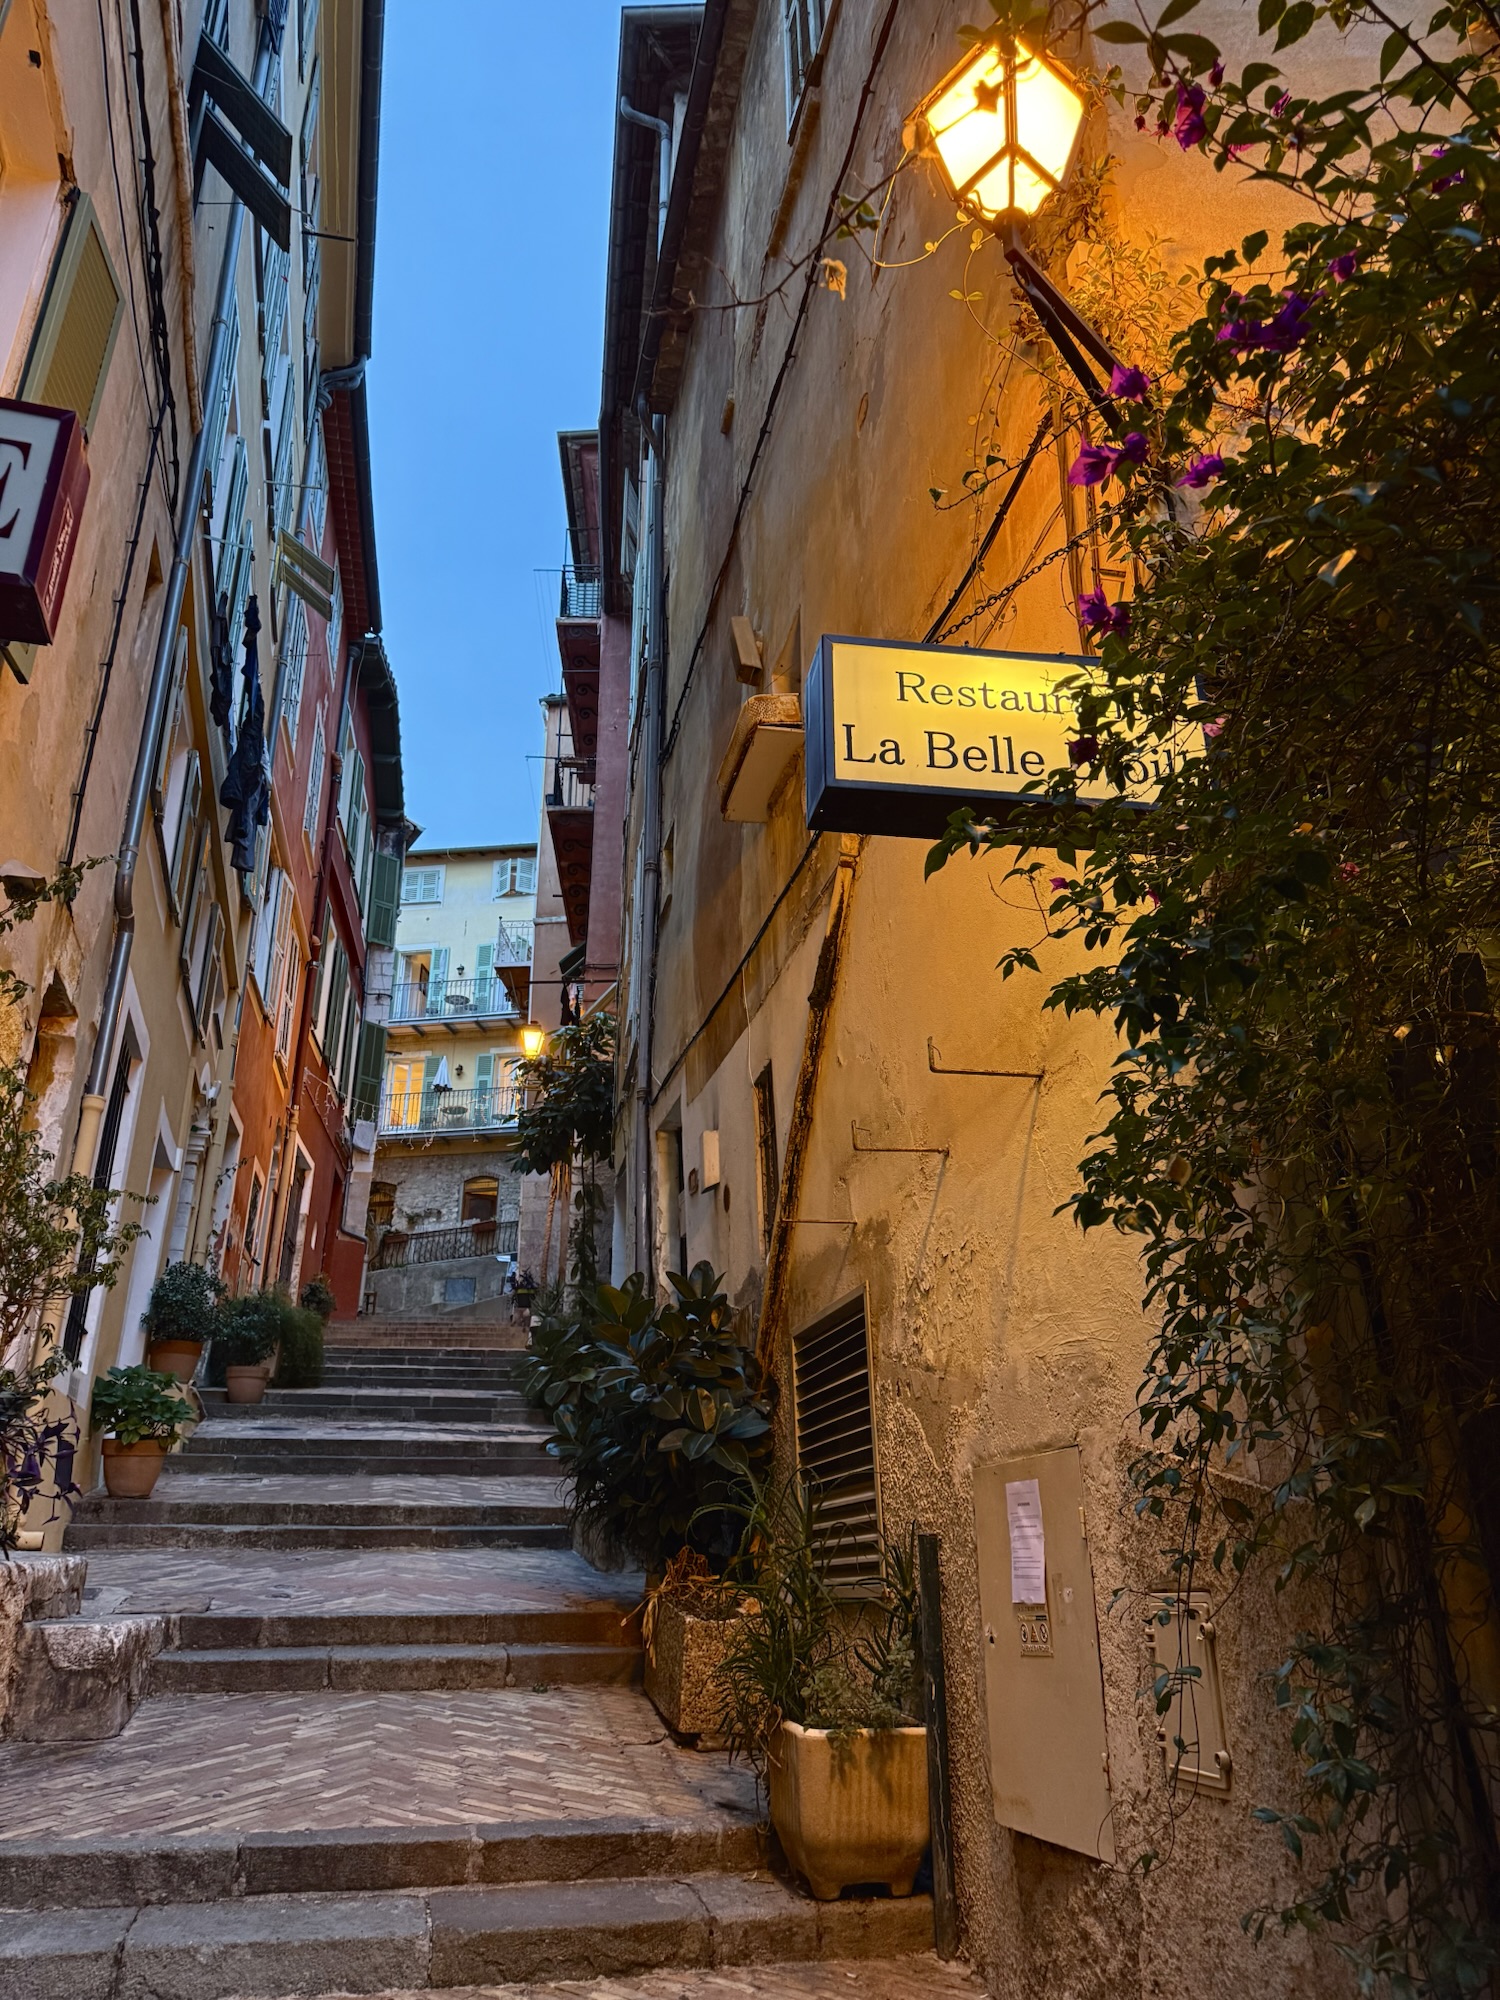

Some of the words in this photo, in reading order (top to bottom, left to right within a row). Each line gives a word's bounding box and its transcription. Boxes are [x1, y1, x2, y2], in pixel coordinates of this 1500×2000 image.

[895, 671, 1143, 721] Restaur
[842, 723, 905, 766] La
[924, 730, 1045, 777] Belle
